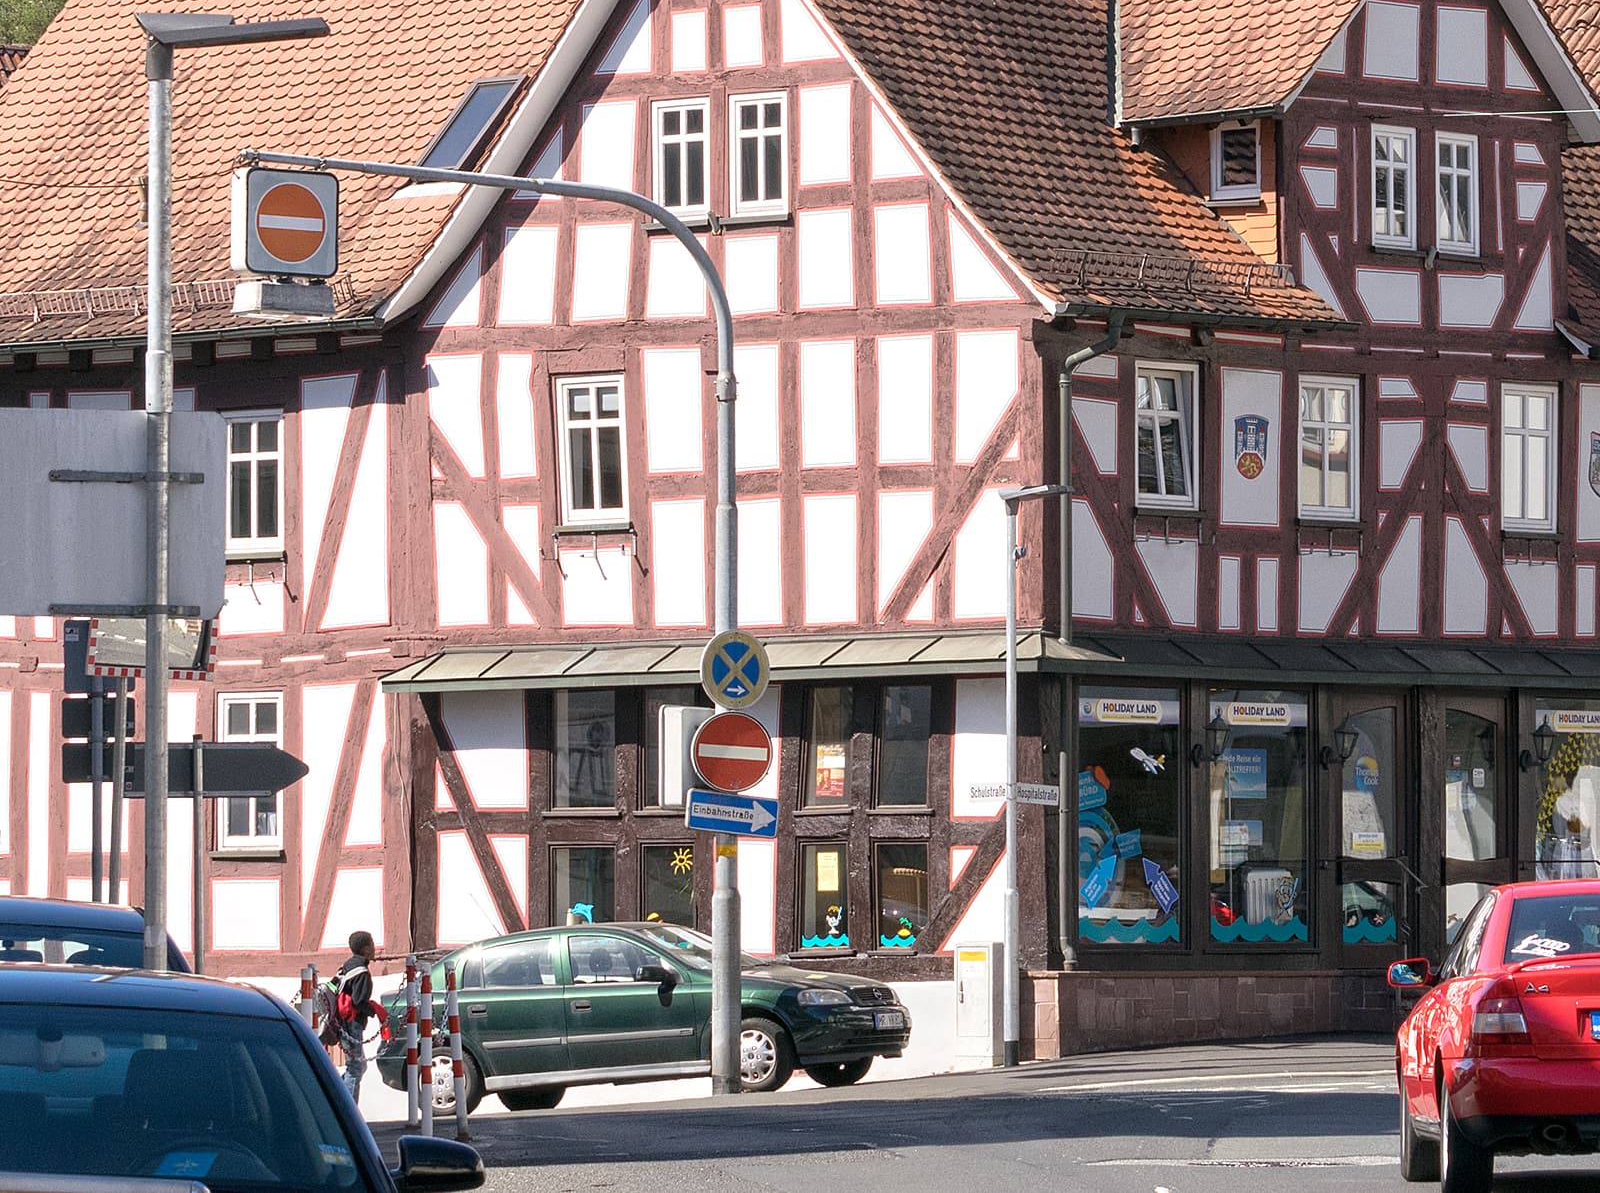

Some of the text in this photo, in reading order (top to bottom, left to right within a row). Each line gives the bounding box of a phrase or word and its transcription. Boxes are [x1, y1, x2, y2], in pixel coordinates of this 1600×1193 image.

[1103, 702, 1157, 714] HOLIDAY LAND
[1233, 706, 1286, 717] HOLIDAY LAND
[1558, 713, 1586, 723] HOLIDAY
[970, 785, 1006, 799] Schulstraße
[1017, 786, 1058, 801] Hospitalstraße
[693, 804, 754, 820] Einbahnstraße
